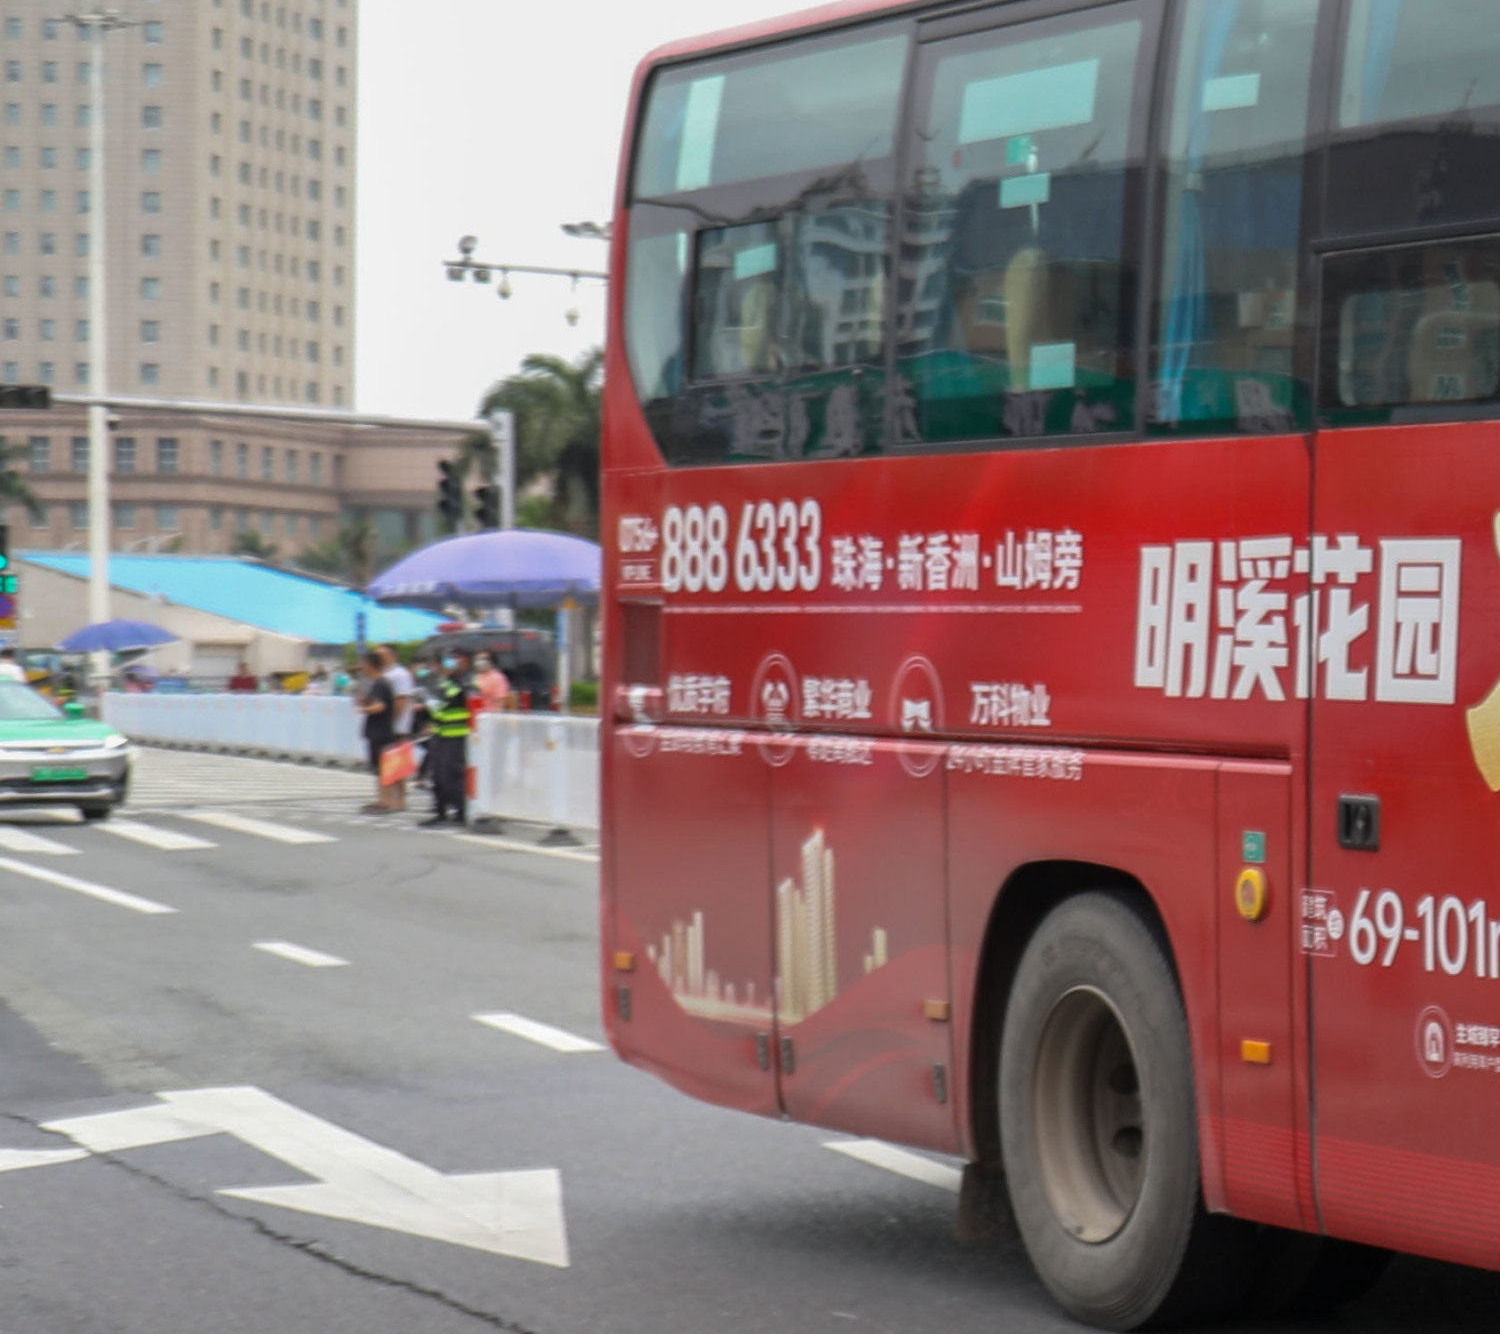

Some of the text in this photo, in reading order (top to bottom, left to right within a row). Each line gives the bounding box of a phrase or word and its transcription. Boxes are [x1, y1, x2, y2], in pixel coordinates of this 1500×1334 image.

[662, 500, 822, 593] 888 6333
[1134, 533, 1462, 704] 明溪花园
[802, 675, 873, 719] 繁华商业
[970, 682, 1052, 726] 万科物业
